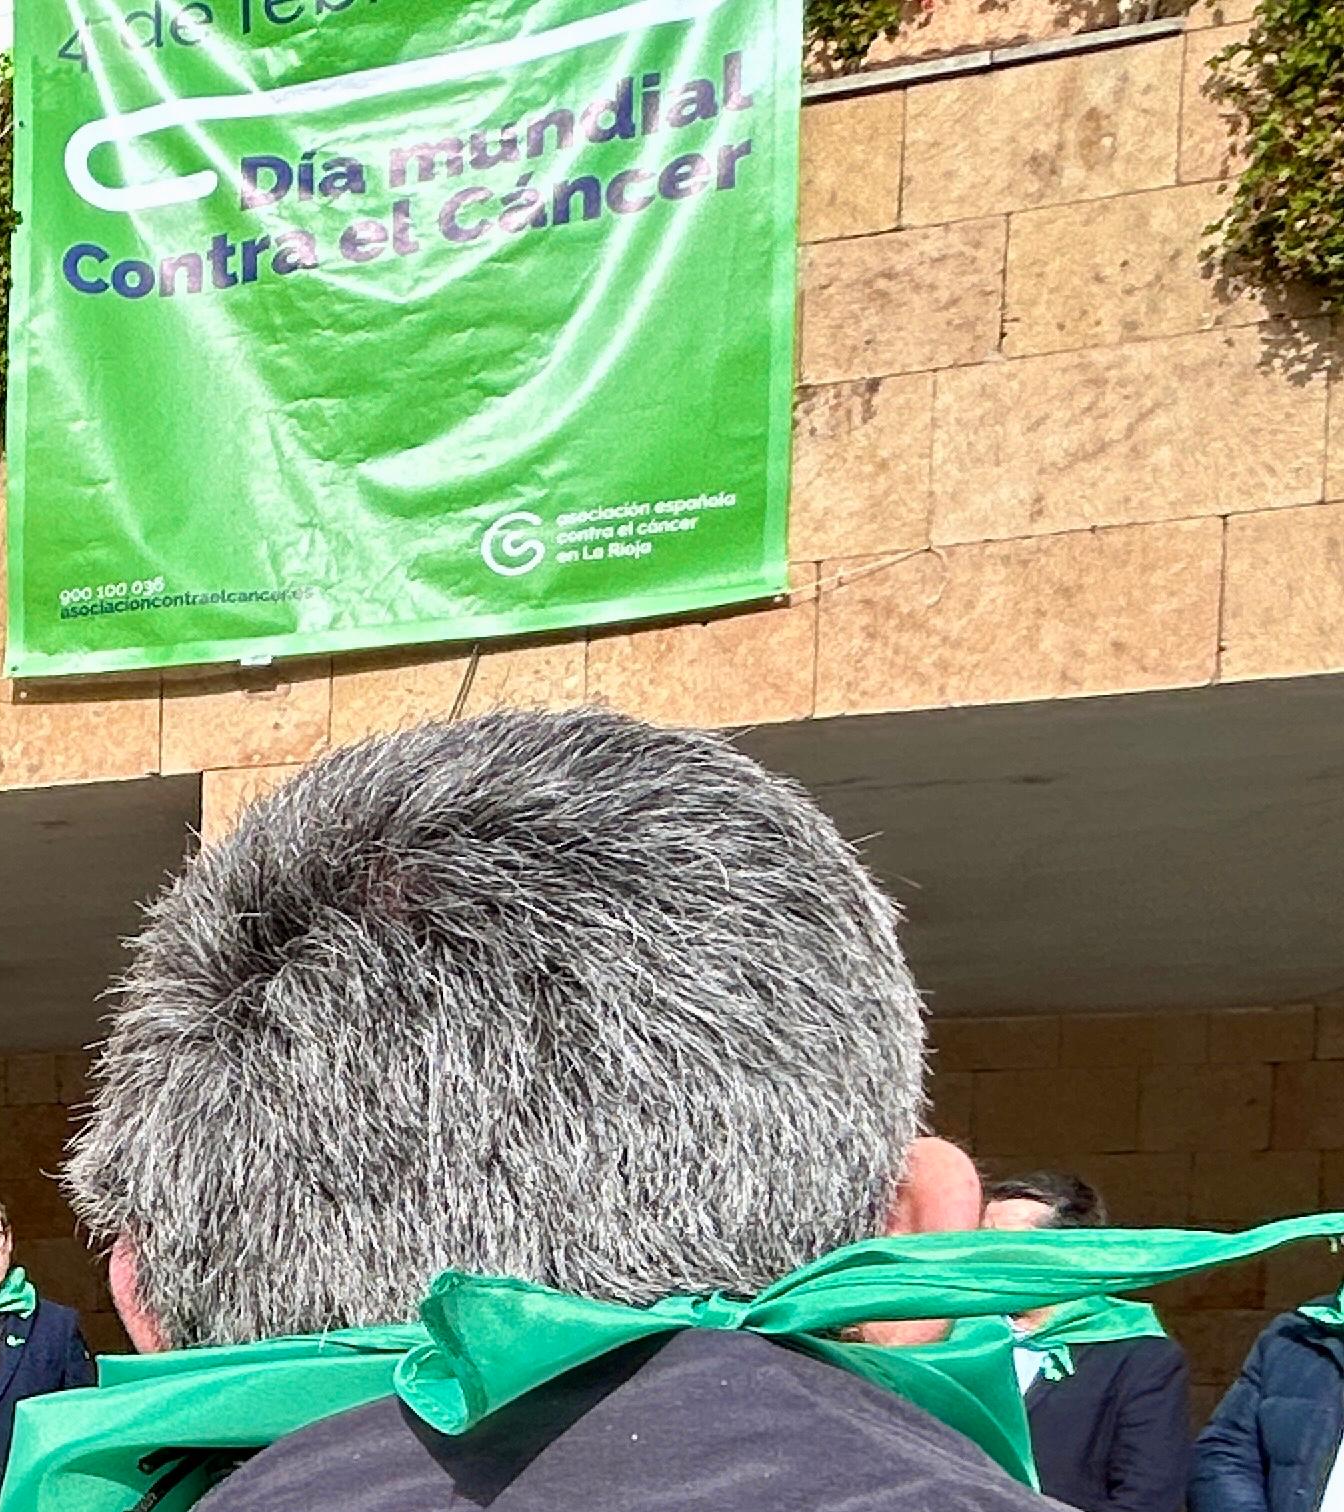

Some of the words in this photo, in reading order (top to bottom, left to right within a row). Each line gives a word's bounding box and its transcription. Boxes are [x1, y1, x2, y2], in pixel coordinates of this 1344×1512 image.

[57, 16, 89, 73] 4
[121, 0, 214, 49] de
[240, 149, 366, 211] Día
[389, 50, 754, 188] mundial
[62, 232, 320, 299] Contra
[339, 199, 420, 262] el
[438, 139, 753, 244] Cáncer
[555, 501, 650, 527] asociación
[653, 491, 737, 516] española
[555, 525, 615, 545] contra
[616, 521, 634, 538] el
[636, 516, 700, 535] cáncer
[555, 550, 580, 564] en
[582, 545, 605, 560] La
[607, 541, 653, 560] Rioja
[95, 582, 128, 599] 100
